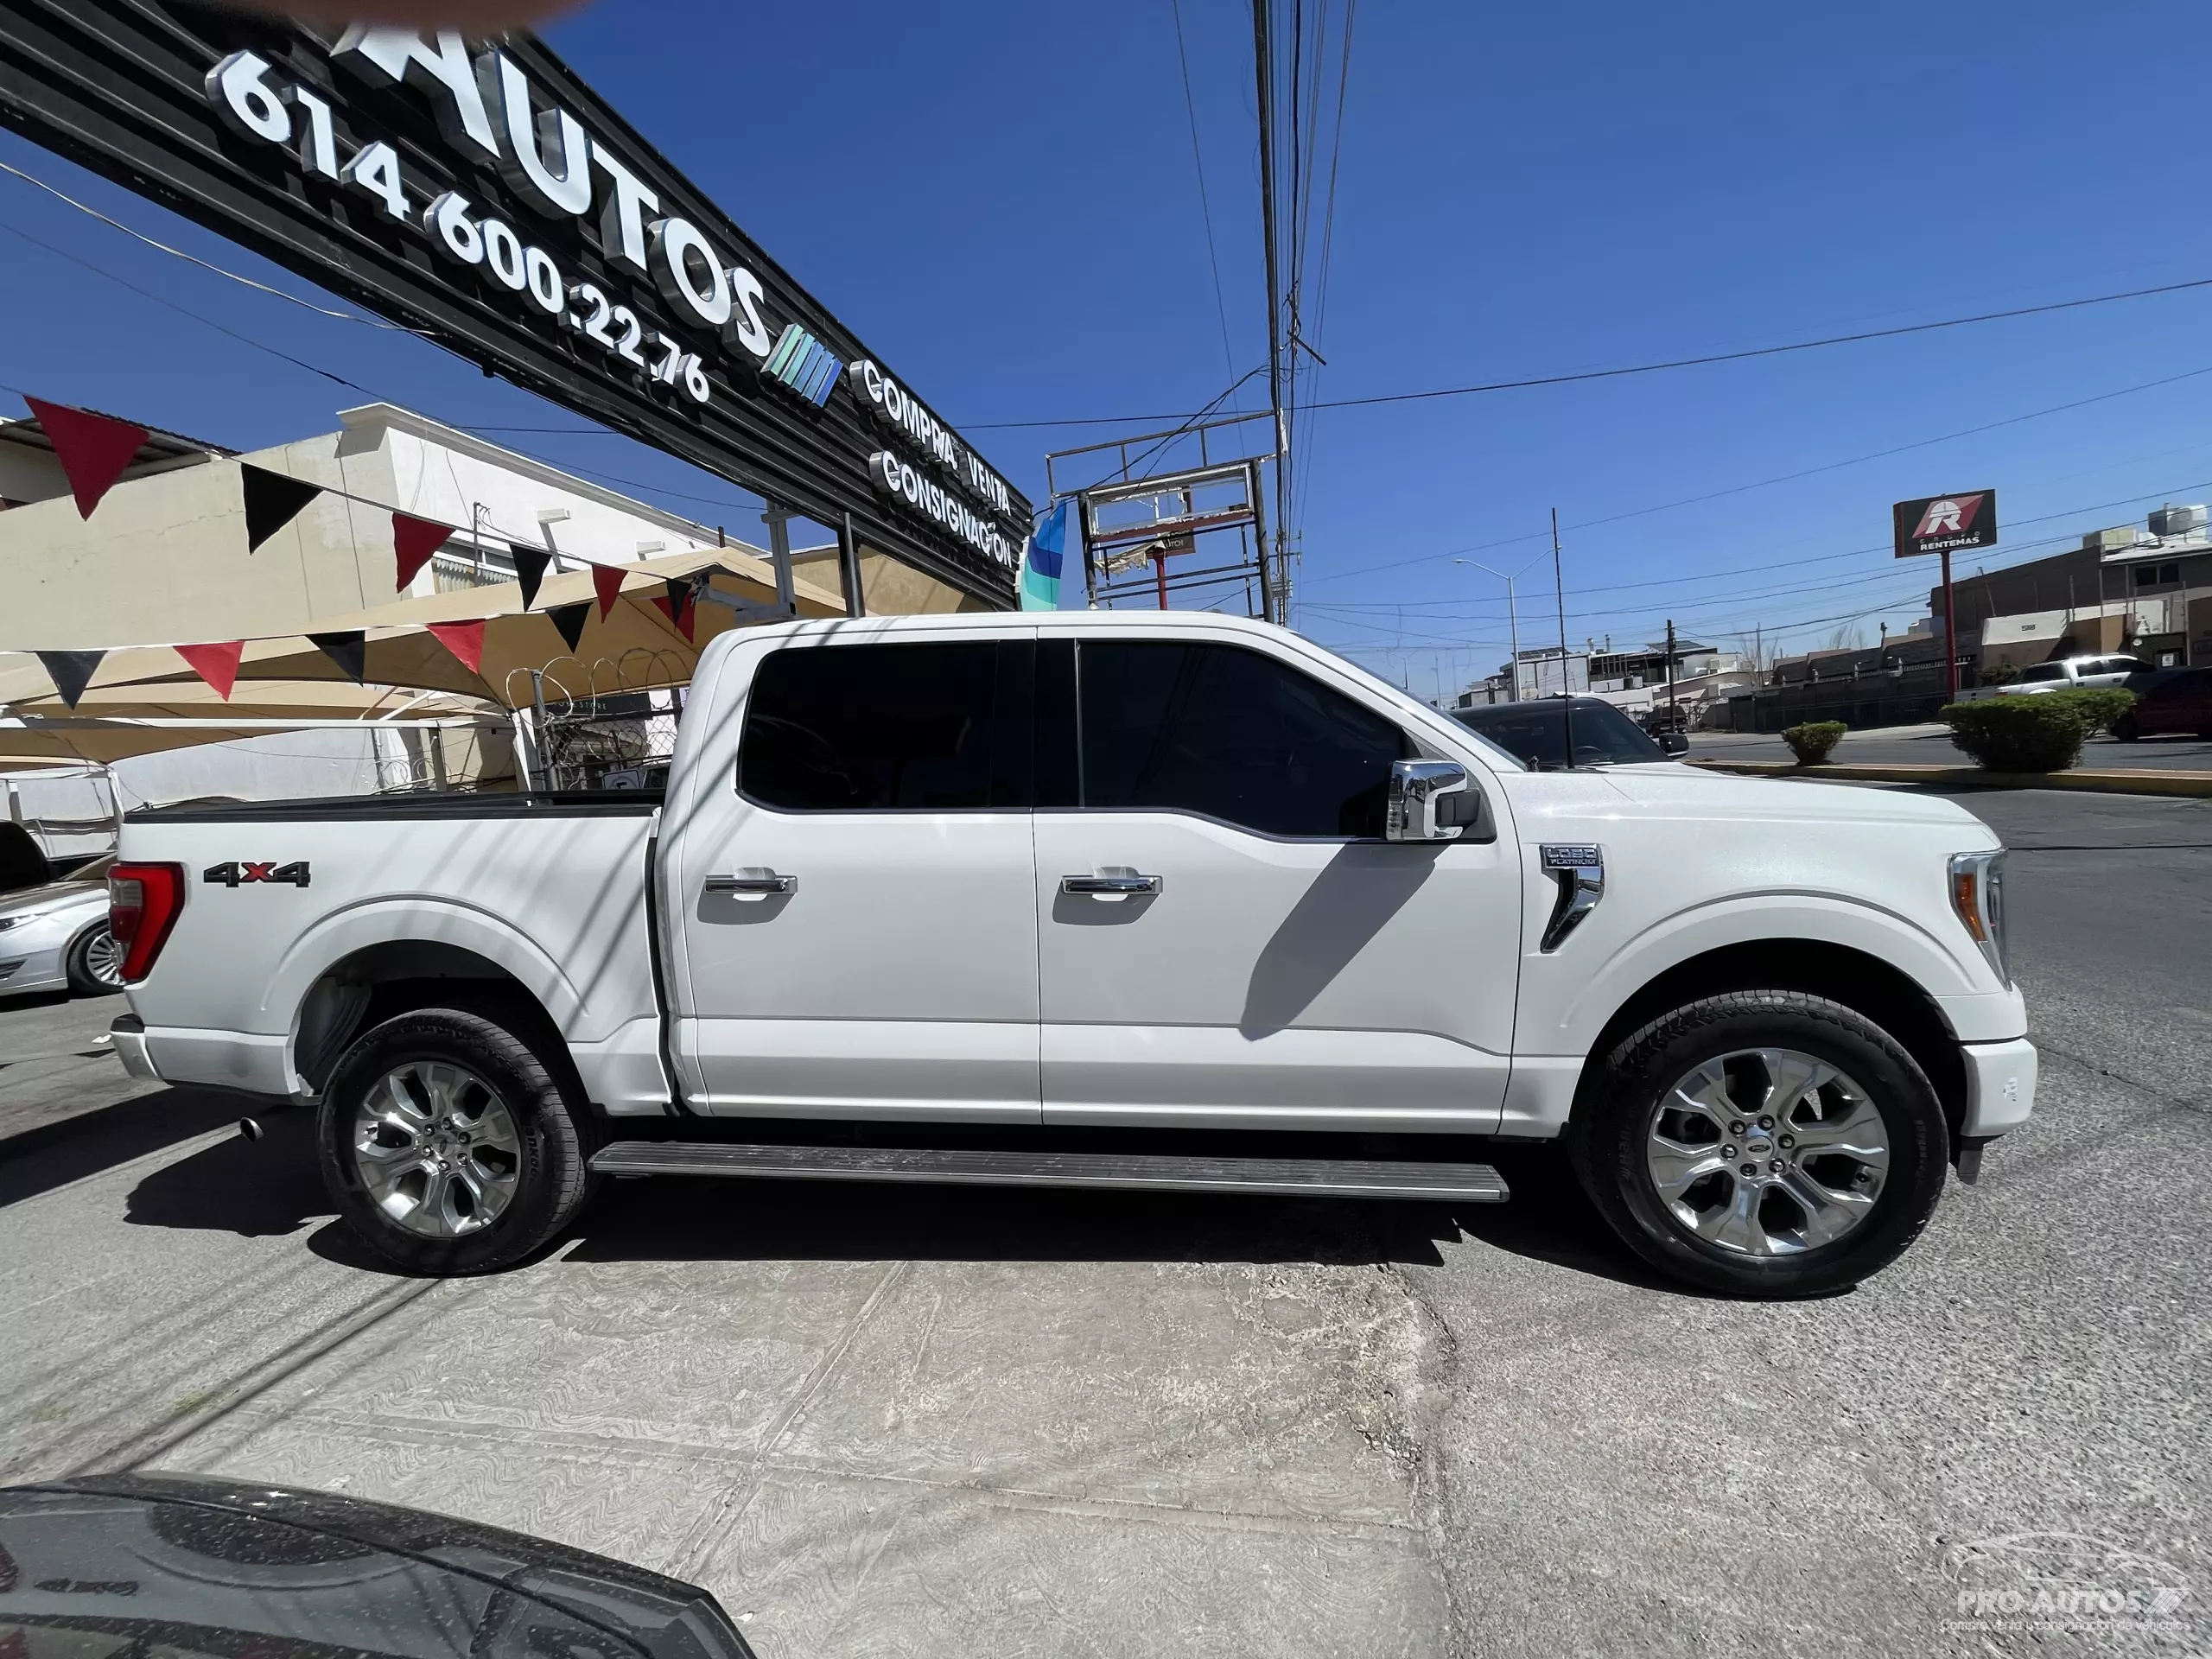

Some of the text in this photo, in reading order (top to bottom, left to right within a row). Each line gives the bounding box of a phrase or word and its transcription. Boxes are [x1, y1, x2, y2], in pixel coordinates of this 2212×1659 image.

[221, 50, 410, 222] 614
[355, 28, 772, 358] AUTOS
[882, 450, 1012, 569] CONSIGNACÓN
[967, 451, 1012, 517] VENTA
[1920, 537, 1980, 551] RENTEMAS
